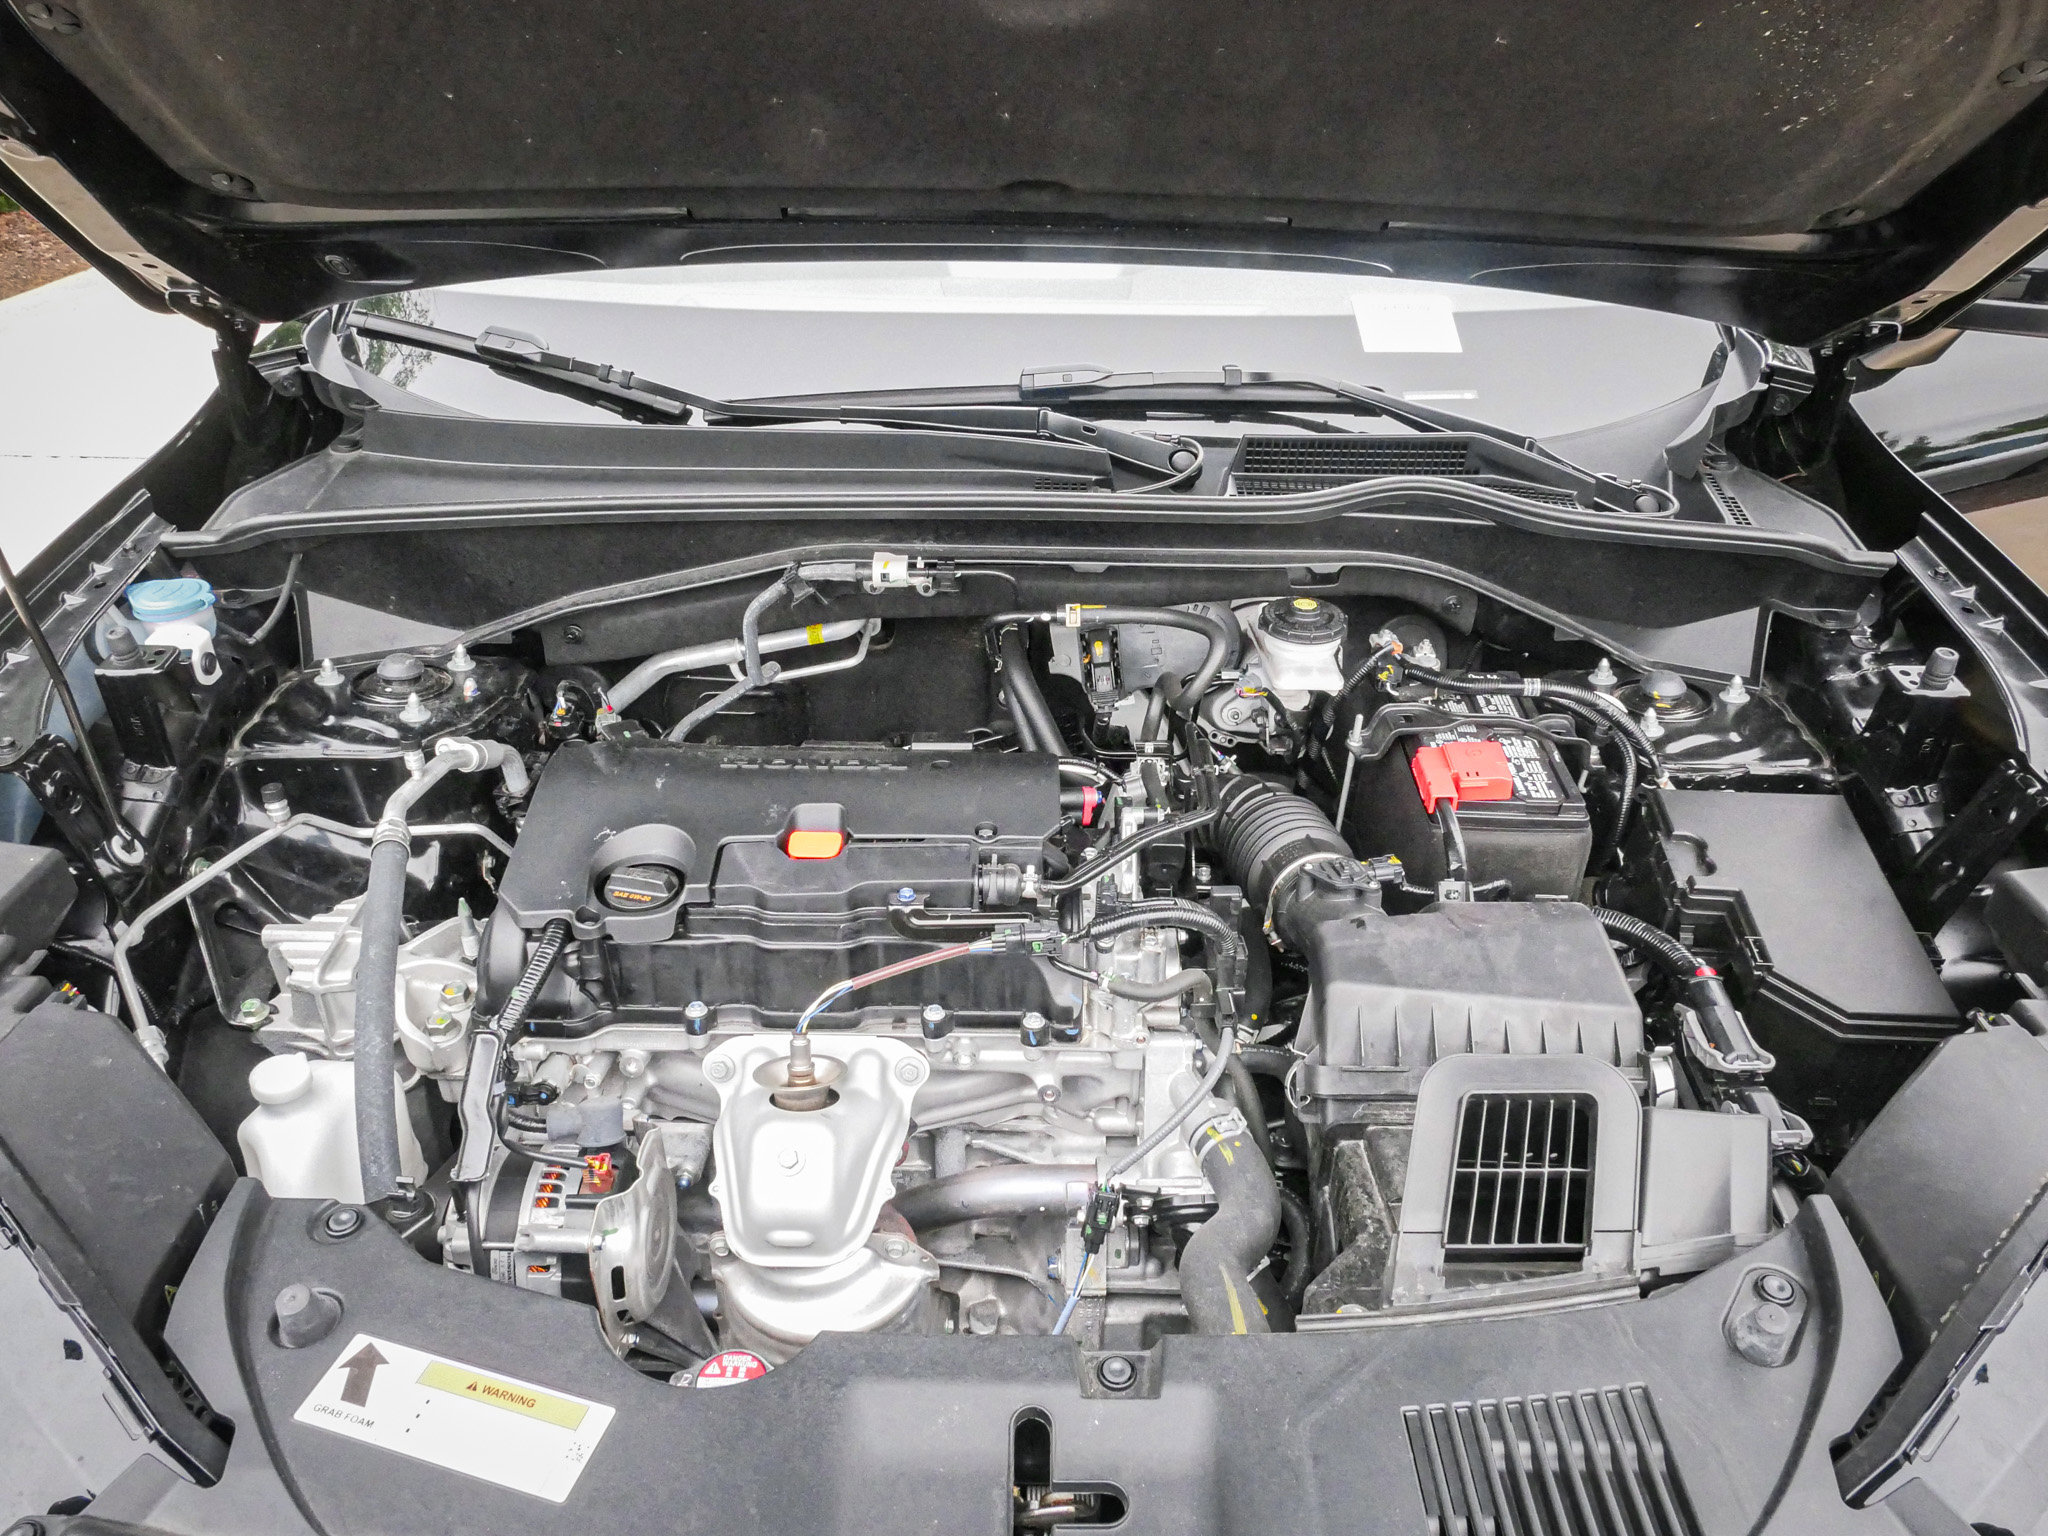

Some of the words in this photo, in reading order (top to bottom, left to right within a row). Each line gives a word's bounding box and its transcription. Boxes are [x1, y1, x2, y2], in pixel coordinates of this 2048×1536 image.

[629, 893, 652, 901] 0W-20
[482, 1385, 537, 1408] WARNING
[313, 1403, 343, 1419] GRAB
[344, 1413, 375, 1428] FOAM
